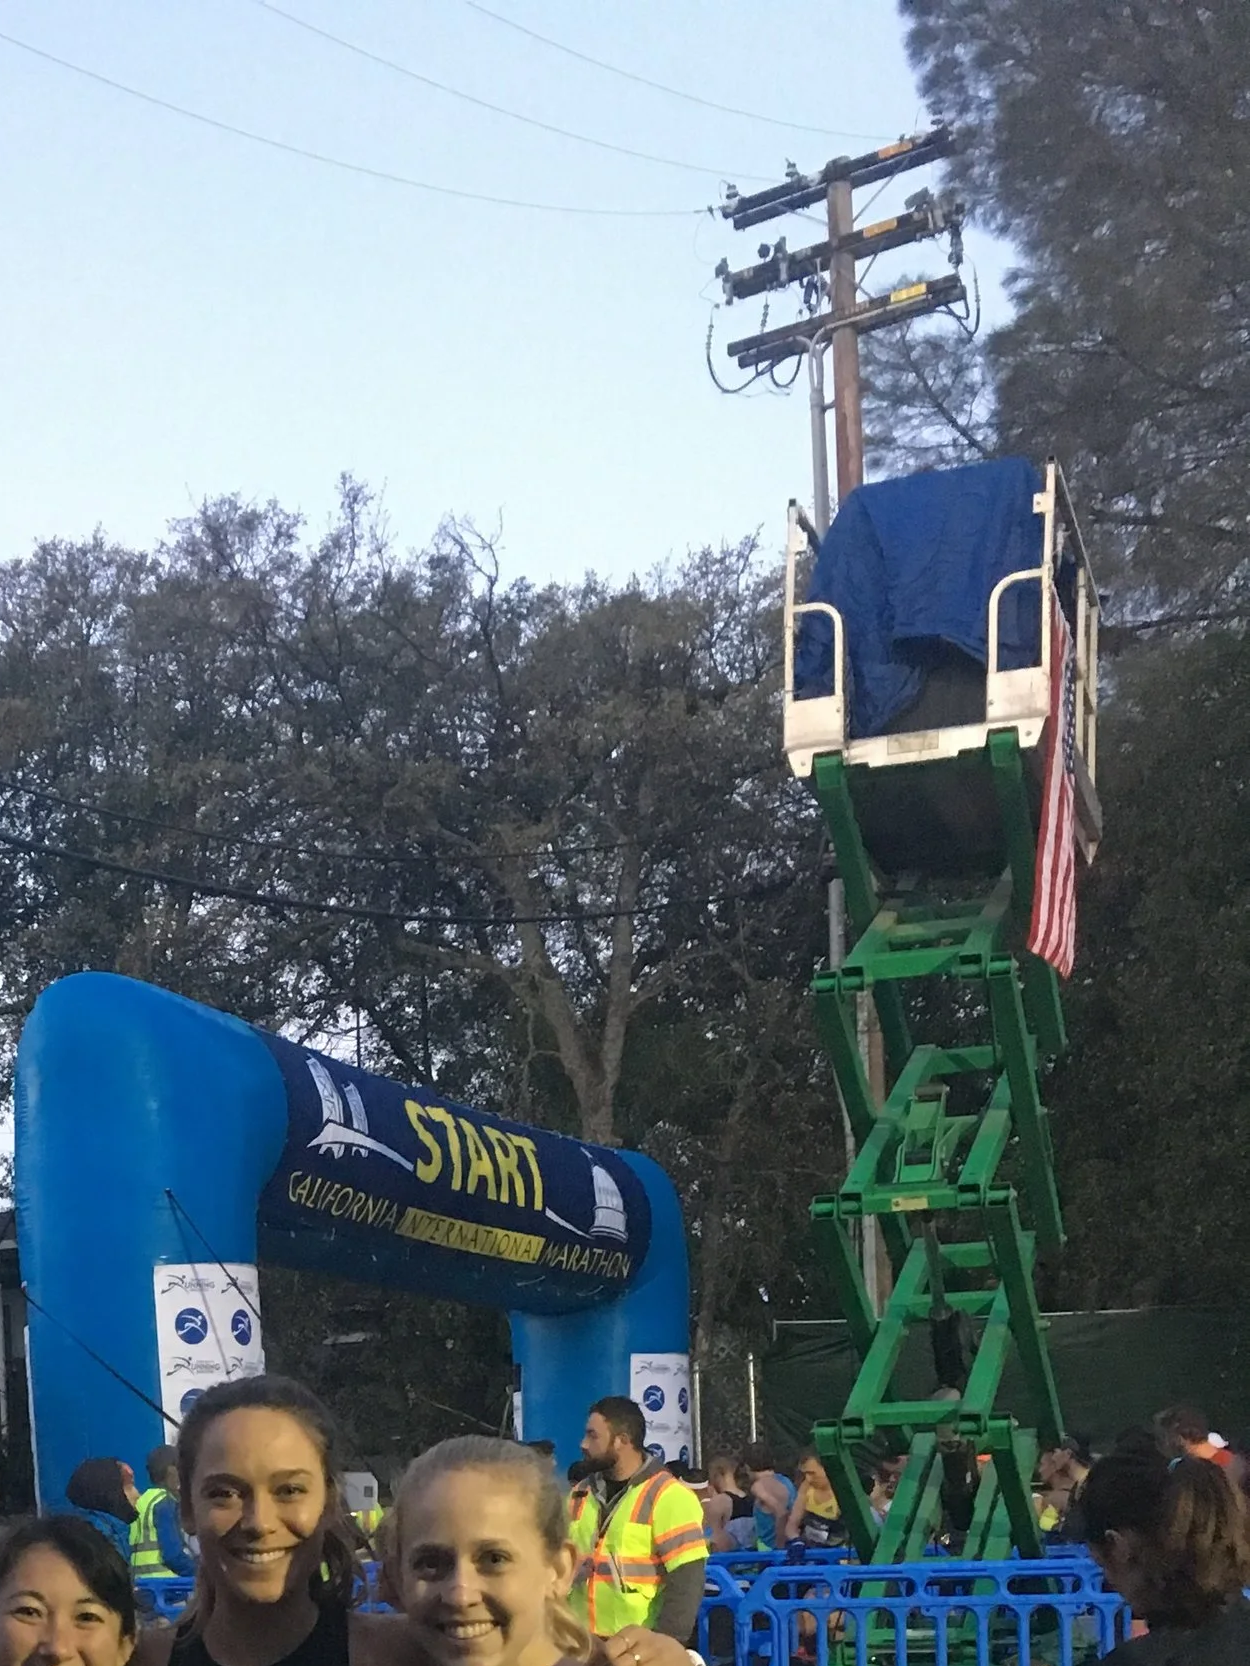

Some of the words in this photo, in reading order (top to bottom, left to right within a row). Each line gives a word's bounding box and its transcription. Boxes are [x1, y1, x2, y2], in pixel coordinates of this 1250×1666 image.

[405, 1099, 544, 1211] START
[288, 1170, 398, 1228] CALIFORNIA
[397, 1208, 544, 1263] INTERNATIONAL
[539, 1245, 631, 1280] MARATHON
